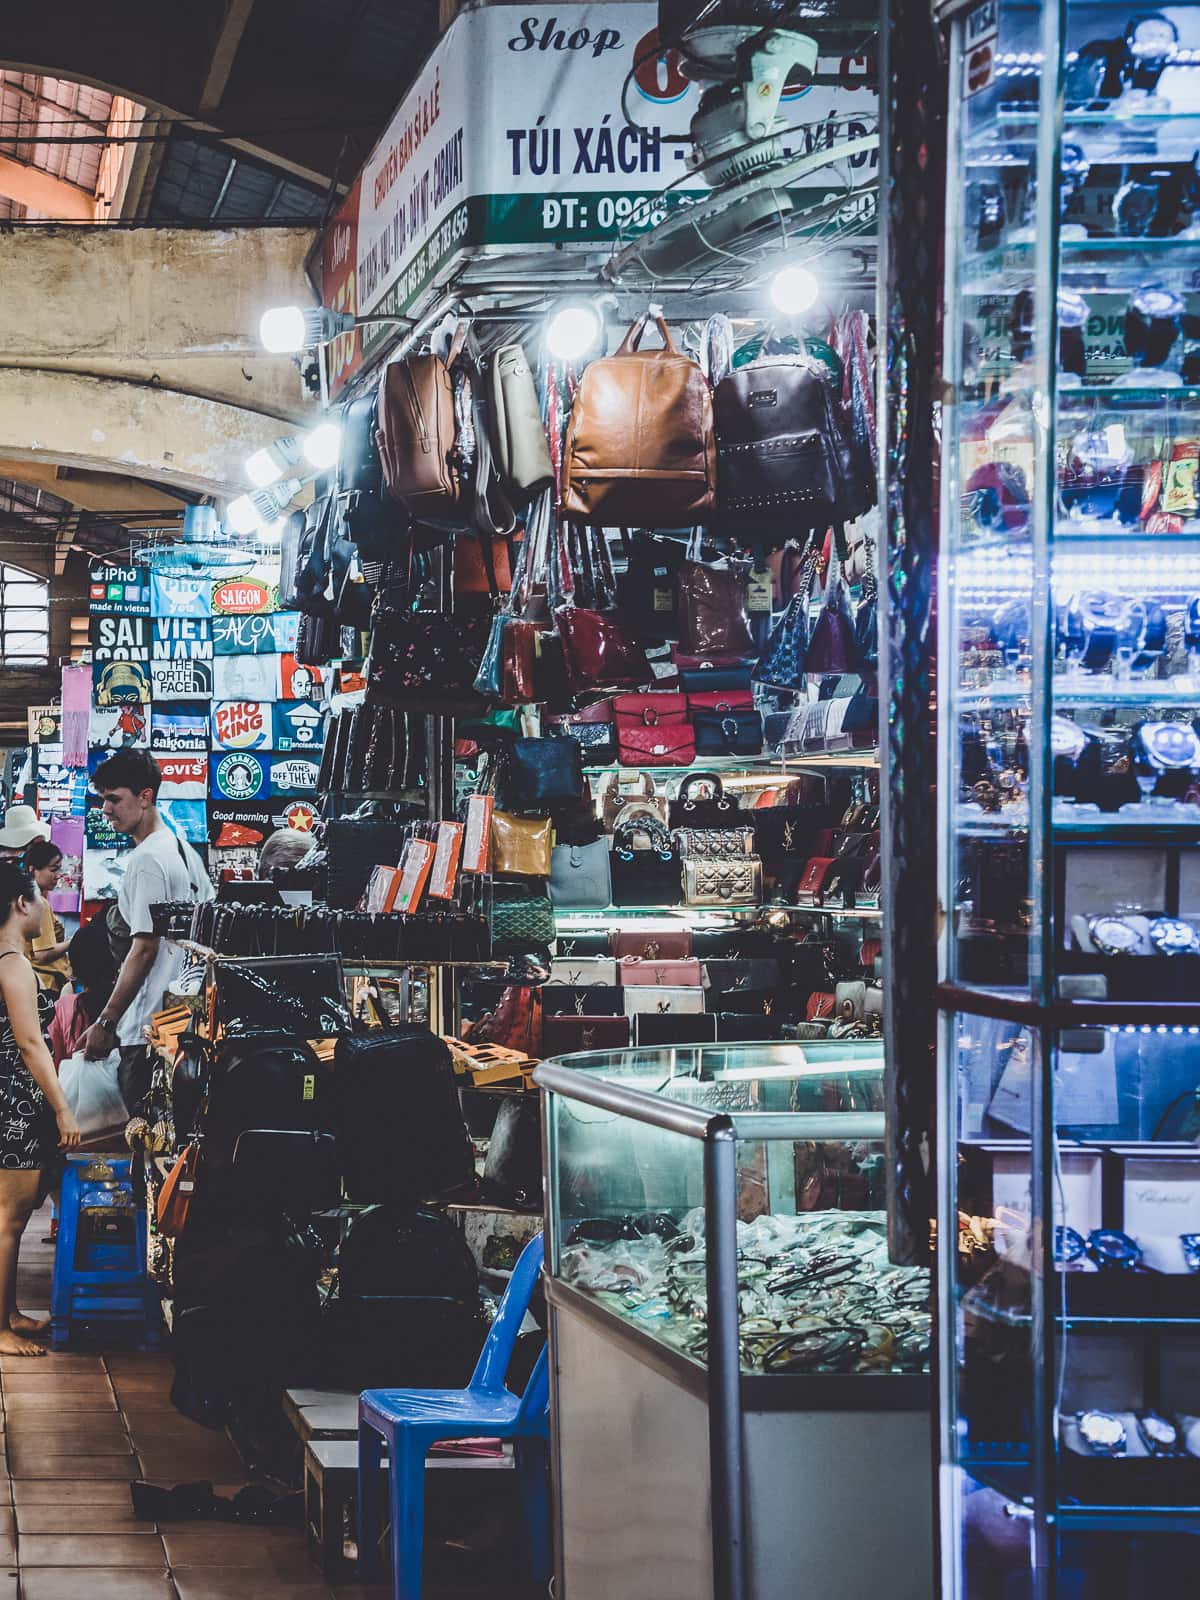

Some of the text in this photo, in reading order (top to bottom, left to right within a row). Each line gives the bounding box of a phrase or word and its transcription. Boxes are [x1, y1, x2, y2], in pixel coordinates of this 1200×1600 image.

[507, 17, 625, 58] Shop
[506, 114, 561, 176] TÚI
[572, 113, 661, 174] XÁCH
[542, 198, 588, 229] ĐT:
[220, 589, 261, 606] SAIGON
[89, 602, 111, 612] made
[114, 604, 122, 612] in
[100, 618, 143, 646] SAI
[153, 640, 212, 660] NAM
[169, 661, 192, 670] THE
[160, 681, 193, 692] FACE
[216, 702, 260, 727] PHO
[218, 713, 263, 743] KING
[161, 763, 203, 776] evi's
[272, 771, 287, 780] OFF
[286, 763, 310, 773] VANS
[225, 787, 256, 798] COFFEE
[212, 810, 269, 823] Good morning
